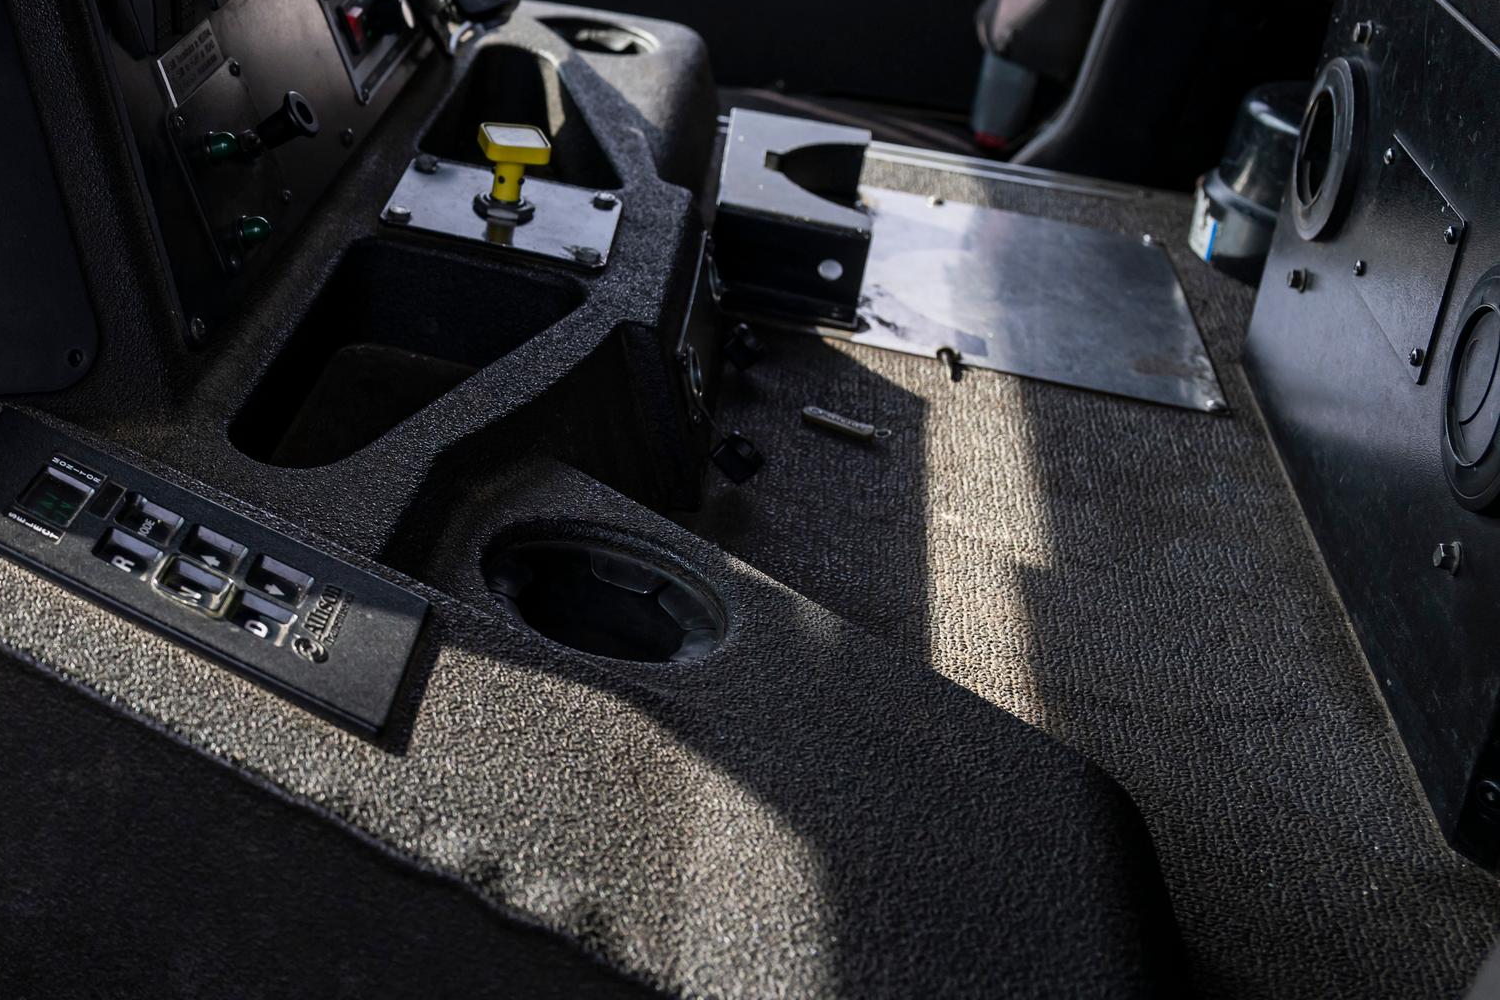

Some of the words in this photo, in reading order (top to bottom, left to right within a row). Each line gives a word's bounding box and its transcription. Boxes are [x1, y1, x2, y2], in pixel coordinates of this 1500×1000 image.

[52, 456, 102, 484] MONITOR
[8, 511, 60, 540] SELECT
[111, 555, 136, 573] R
[302, 584, 343, 638] Allison
[244, 619, 269, 639] D
